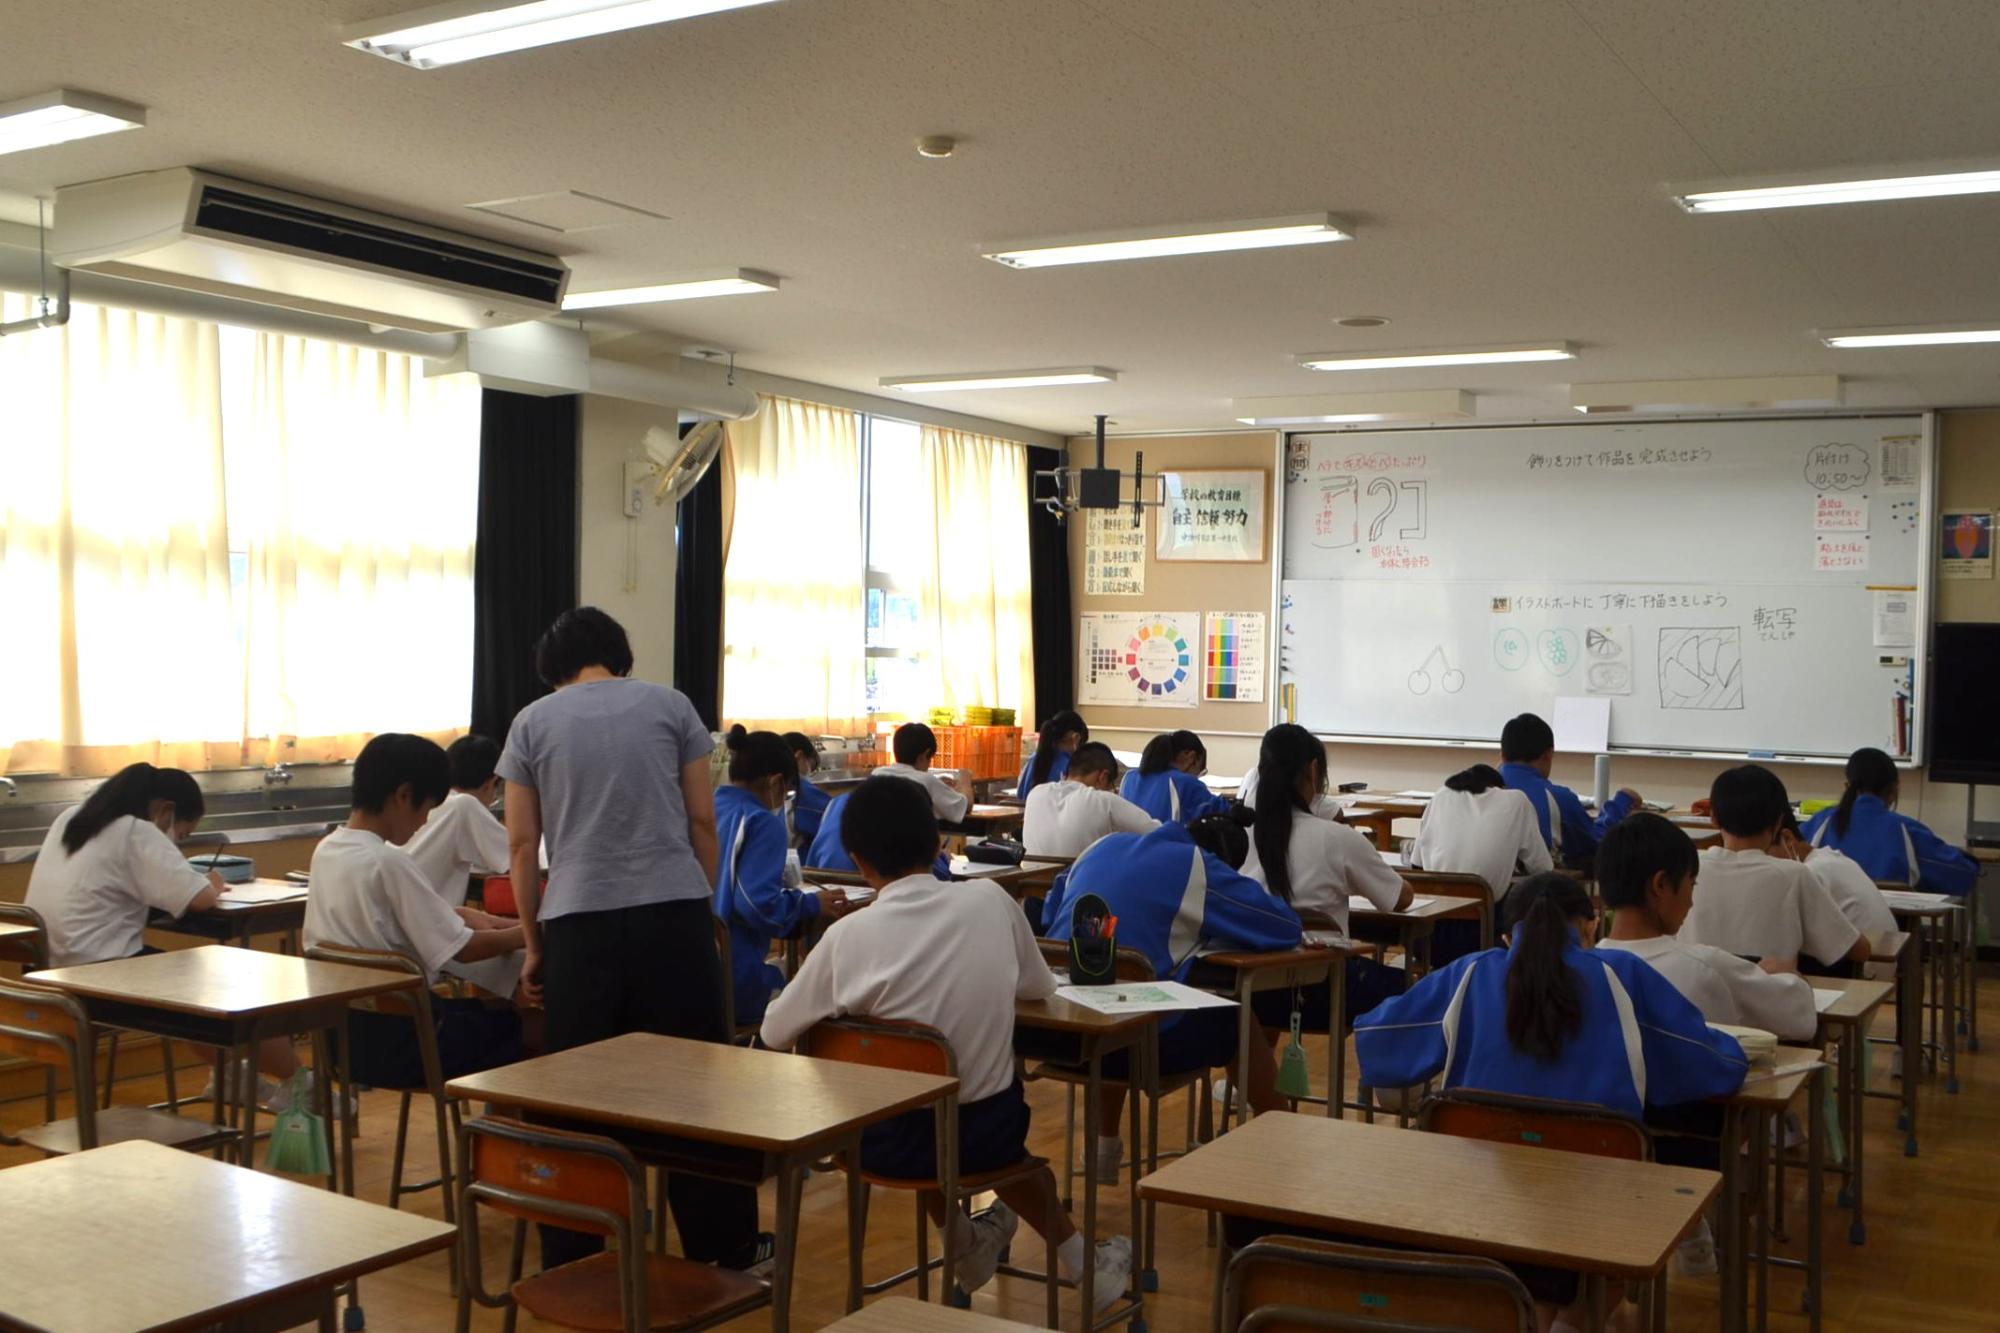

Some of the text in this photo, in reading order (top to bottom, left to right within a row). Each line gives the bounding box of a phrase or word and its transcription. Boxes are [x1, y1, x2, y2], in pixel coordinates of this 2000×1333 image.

[1172, 508, 1249, 528] 自主 信頼 努力
[1752, 606, 1797, 630] 転写
